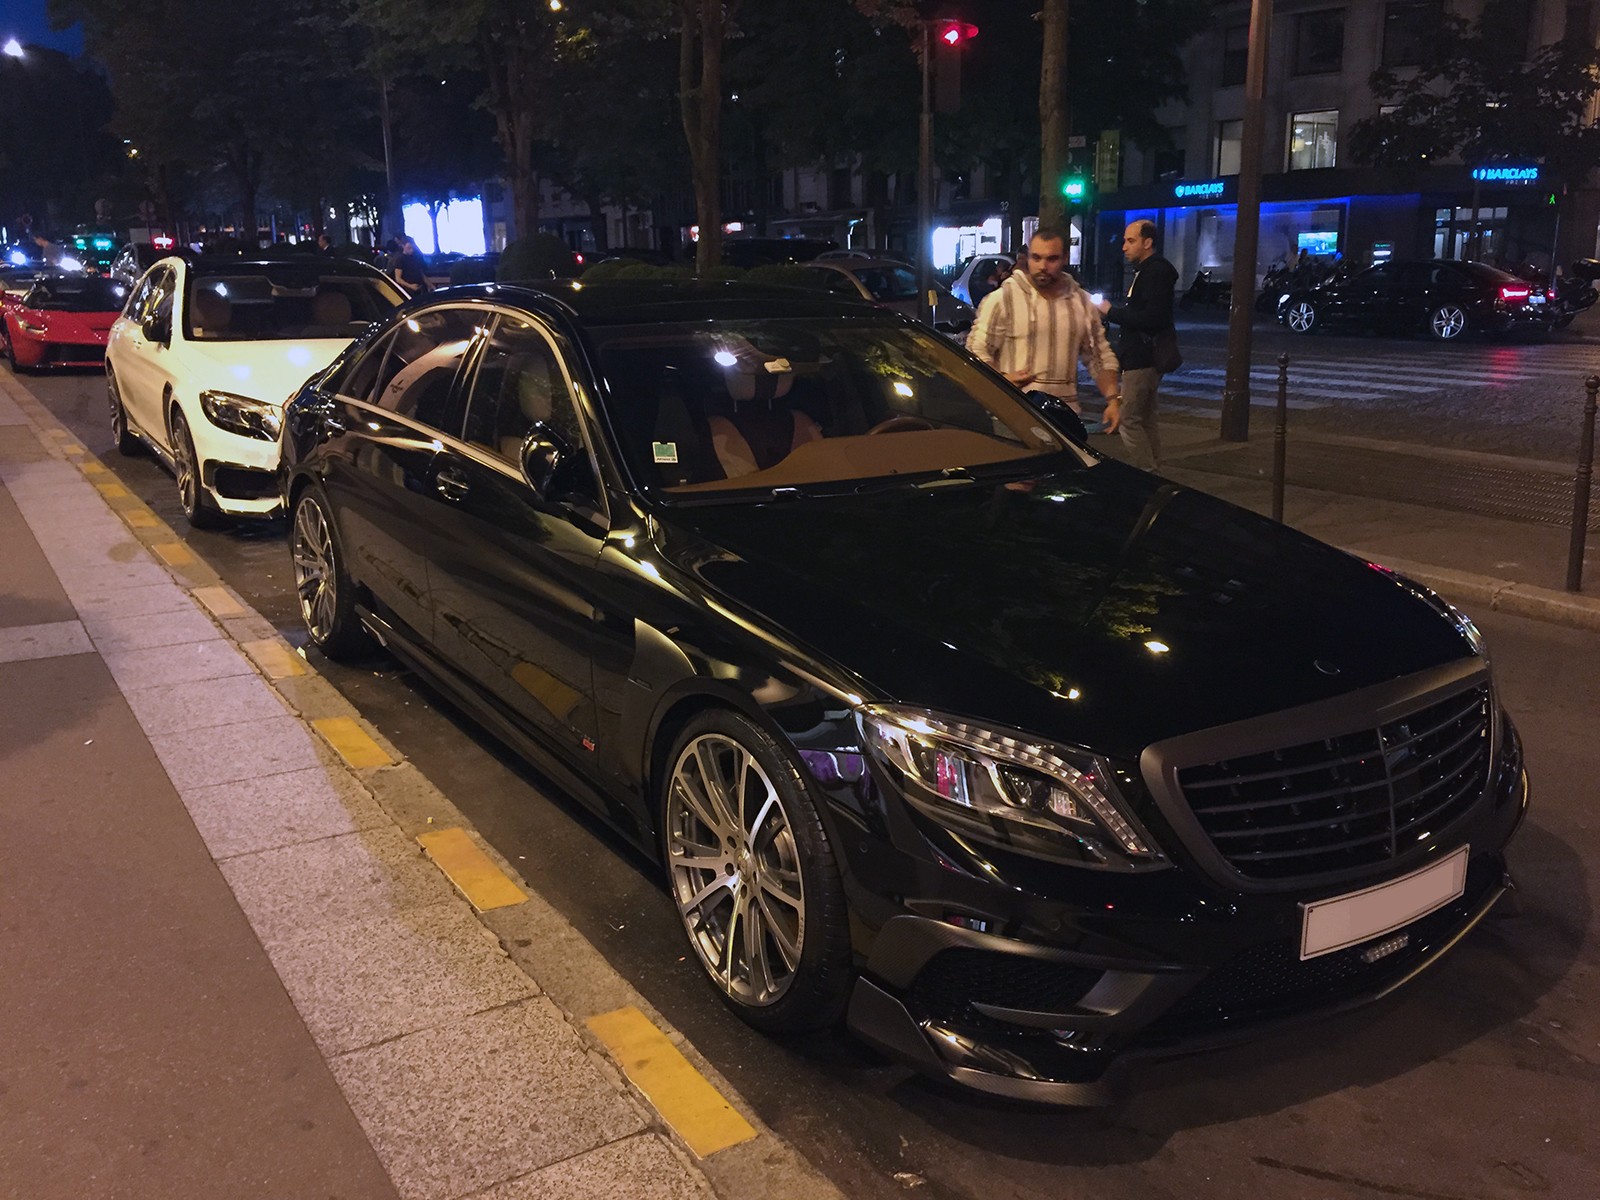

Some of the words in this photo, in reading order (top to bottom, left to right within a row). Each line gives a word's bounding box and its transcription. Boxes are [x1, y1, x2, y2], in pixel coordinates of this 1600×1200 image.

[1486, 168, 1538, 179] BARCLAYS
[1184, 182, 1224, 196] BARCLAYS
[1000, 201, 1010, 211] 32
